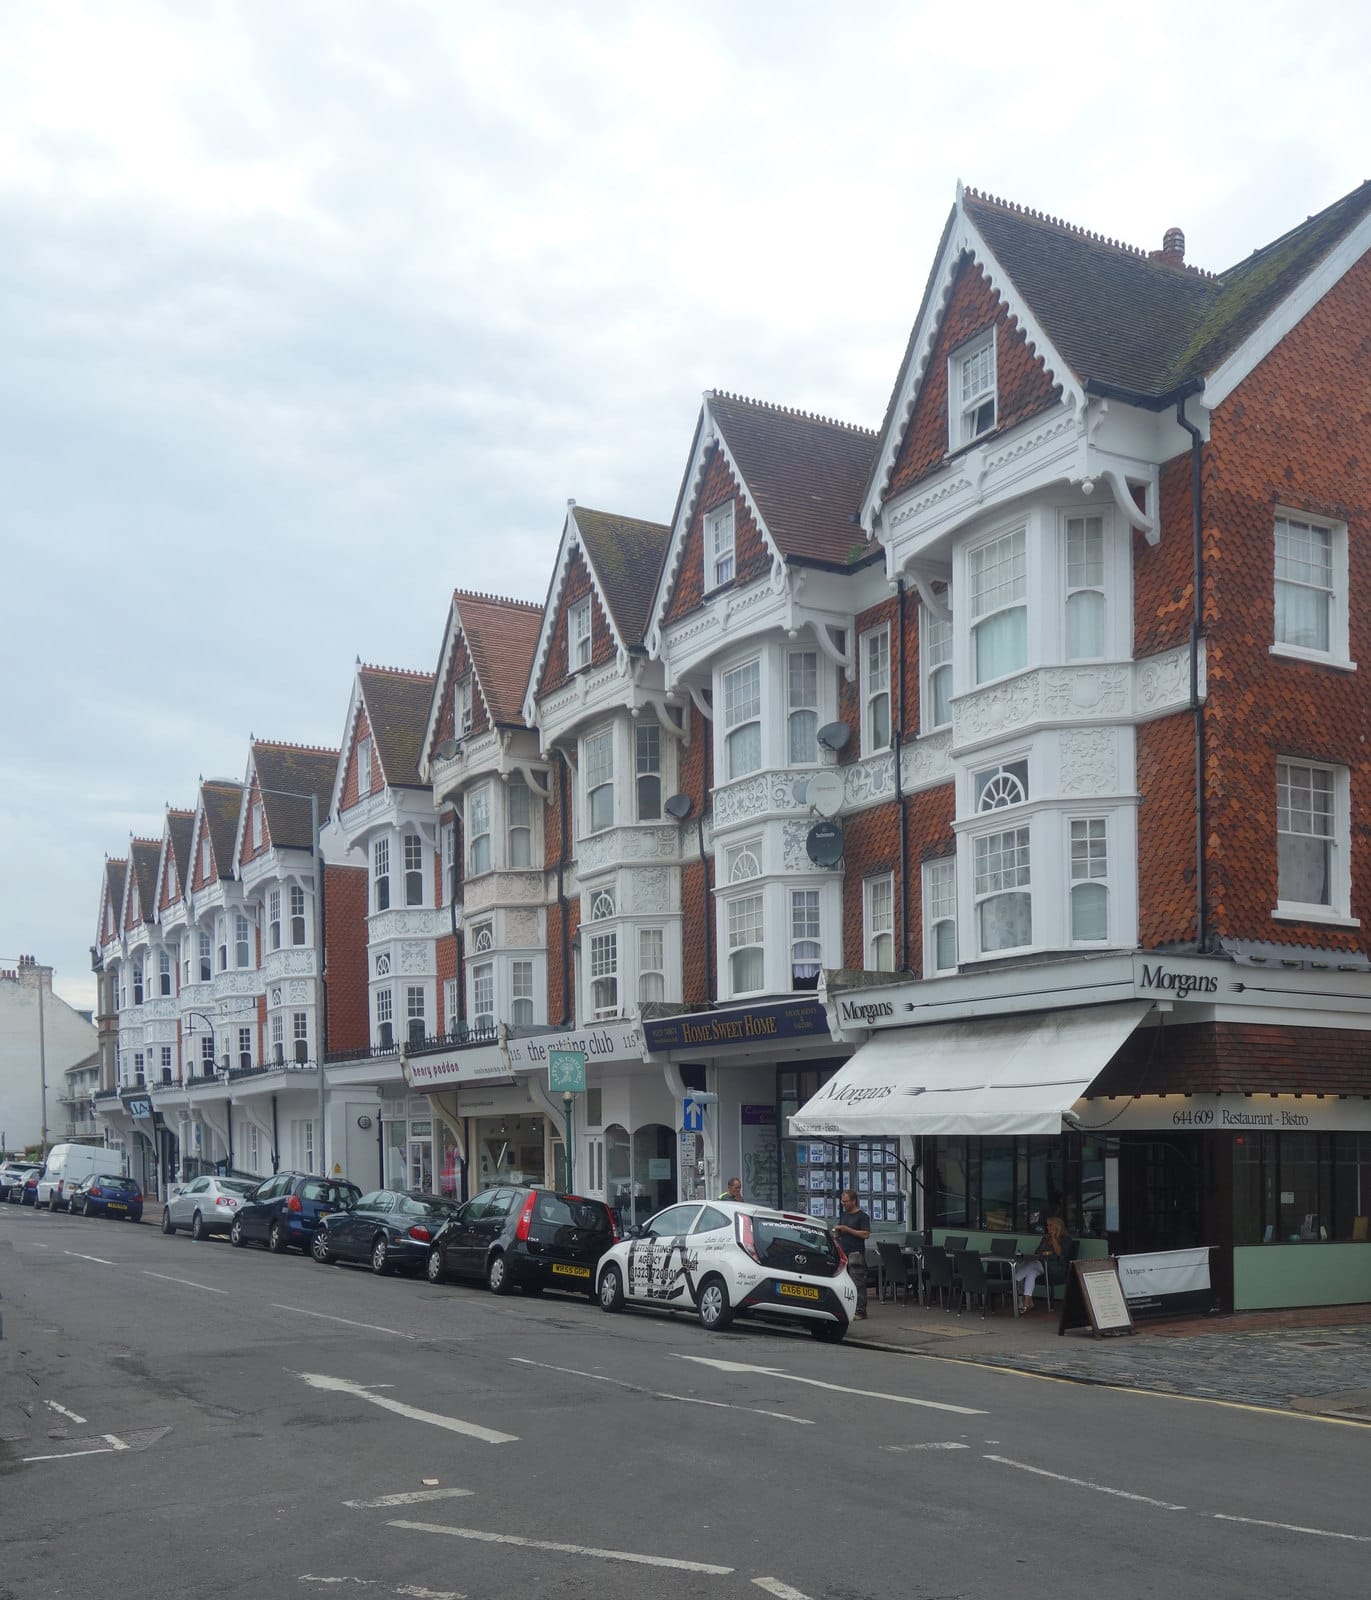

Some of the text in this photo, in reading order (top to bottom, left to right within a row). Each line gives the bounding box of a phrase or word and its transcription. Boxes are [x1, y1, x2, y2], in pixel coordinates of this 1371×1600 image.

[1140, 965, 1218, 998] Morgans
[841, 1001, 893, 1024] Morgans
[681, 1014, 777, 1043] HOME SWEET HOME
[510, 1049, 521, 1061] 115
[527, 1040, 546, 1061] the
[589, 1031, 614, 1054] club
[622, 1035, 636, 1048] 115
[412, 1065, 432, 1079] henry
[433, 1061, 460, 1077] paddon
[818, 1082, 896, 1106] Morgans
[1222, 1109, 1273, 1125] Restaurant
[1281, 1110, 1309, 1126] Bistro
[638, 1255, 661, 1265] AGENCY
[781, 1284, 817, 1297] GX66 UGL
